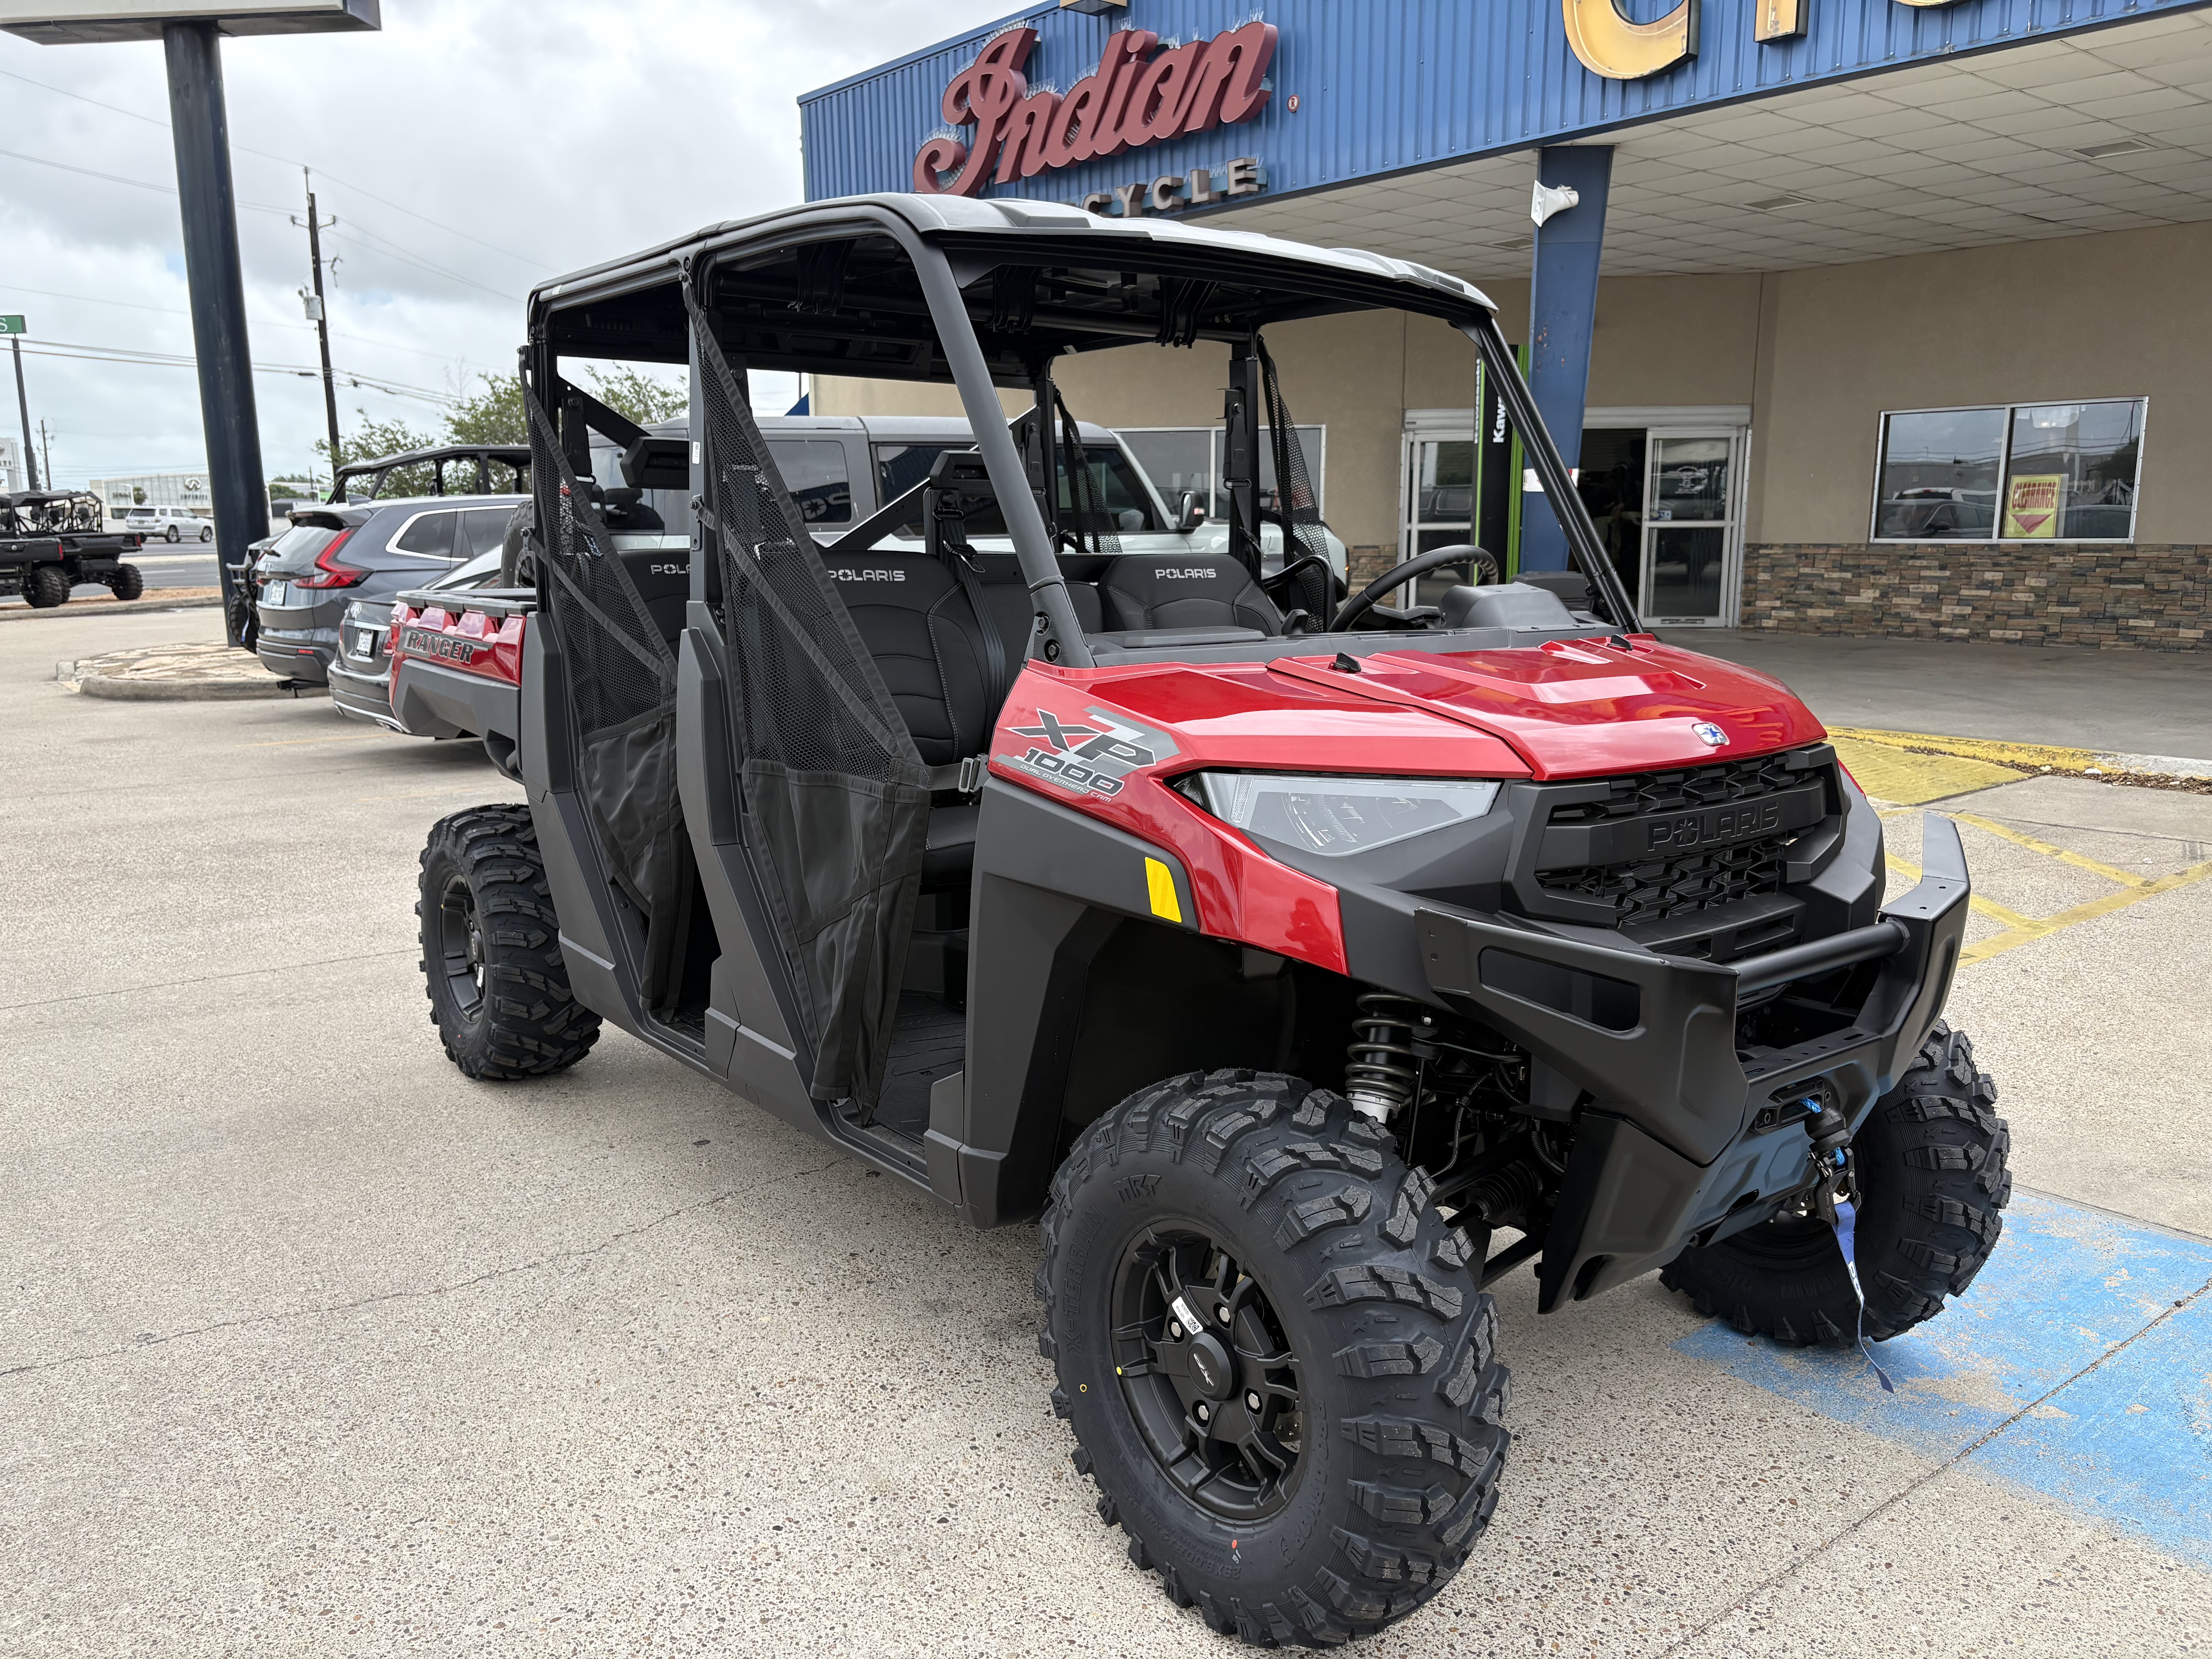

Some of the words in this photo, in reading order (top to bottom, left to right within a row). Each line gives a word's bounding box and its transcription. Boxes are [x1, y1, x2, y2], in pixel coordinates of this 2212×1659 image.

[912, 22, 1279, 197] Indian
[1492, 395, 1505, 443] Kaw
[2012, 482, 2057, 509] CLEARANCE
[828, 569, 906, 582] POLARIS
[1155, 568, 1216, 579] POLARIS
[407, 631, 474, 663] RANGER
[1005, 708, 1157, 768] XP
[1020, 764, 1042, 778] DUAL
[1042, 773, 1090, 795] OVERHEAD
[1090, 789, 1112, 802] CAM
[1024, 747, 1125, 797] 1000
[1647, 801, 1779, 851] POLARIS
[1065, 1205, 1105, 1354] X-TERRAIN
